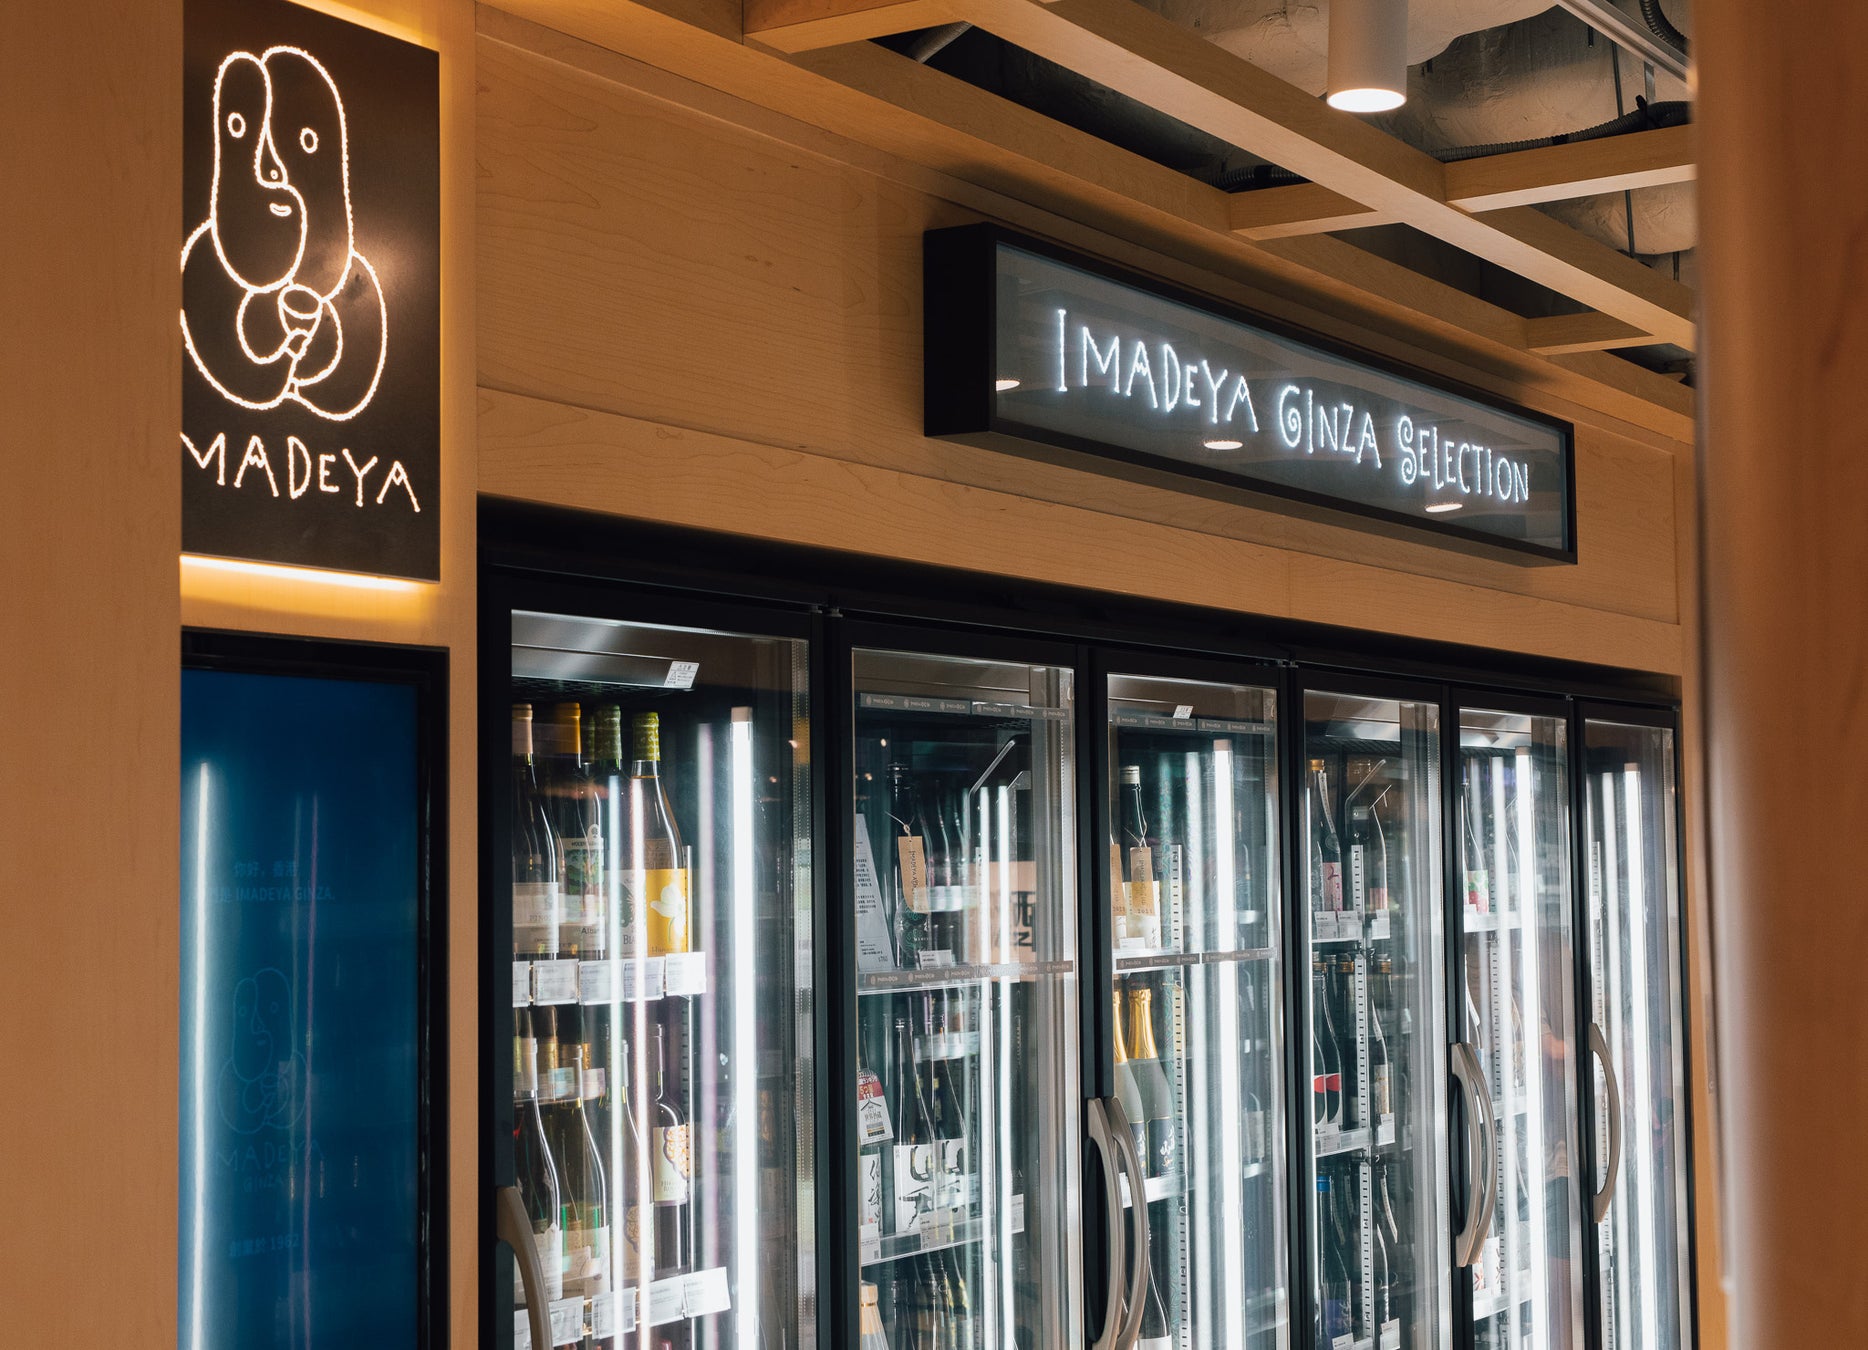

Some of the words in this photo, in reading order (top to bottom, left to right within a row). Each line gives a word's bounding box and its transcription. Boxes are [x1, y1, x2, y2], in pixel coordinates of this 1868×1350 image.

[1057, 308, 1260, 434] IMADEYA
[1278, 384, 1383, 469] GINZA
[1396, 413, 1529, 504] SELECTION
